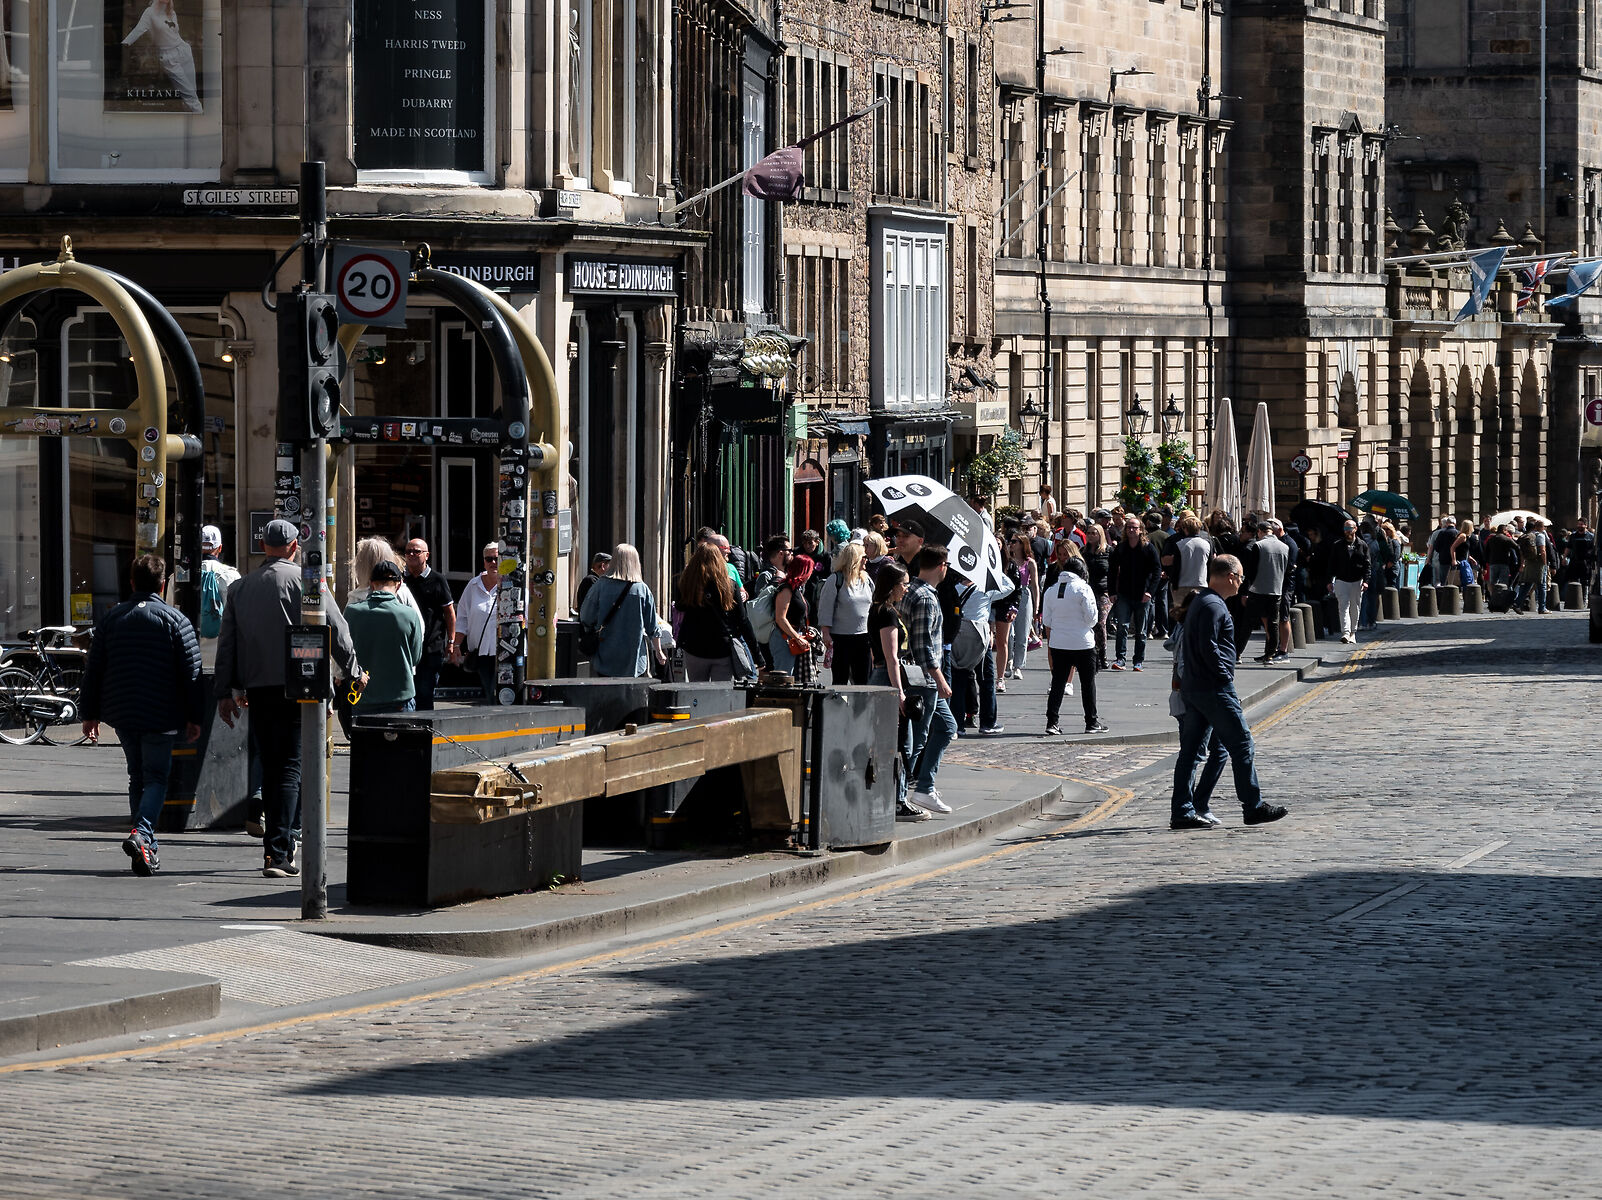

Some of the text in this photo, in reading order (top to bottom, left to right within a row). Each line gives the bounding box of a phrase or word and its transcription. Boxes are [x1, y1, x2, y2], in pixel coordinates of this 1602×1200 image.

[414, 10, 442, 20] NESS
[385, 39, 467, 50] HARRIS TWEED
[404, 68, 452, 79] PRINGLE
[127, 89, 181, 98] KILTANE
[402, 98, 454, 109] DUBARRY
[370, 127, 477, 139] MADE IN SCOTLAND
[248, 190, 296, 204] STREET
[573, 261, 608, 289] HOUSE
[618, 263, 673, 291] EDINBURGH
[348, 271, 391, 300] 20
[1294, 459, 1309, 470] 20
[951, 514, 970, 534] TOWN
[956, 513, 970, 526] OLD
[292, 647, 322, 658] WAIT
